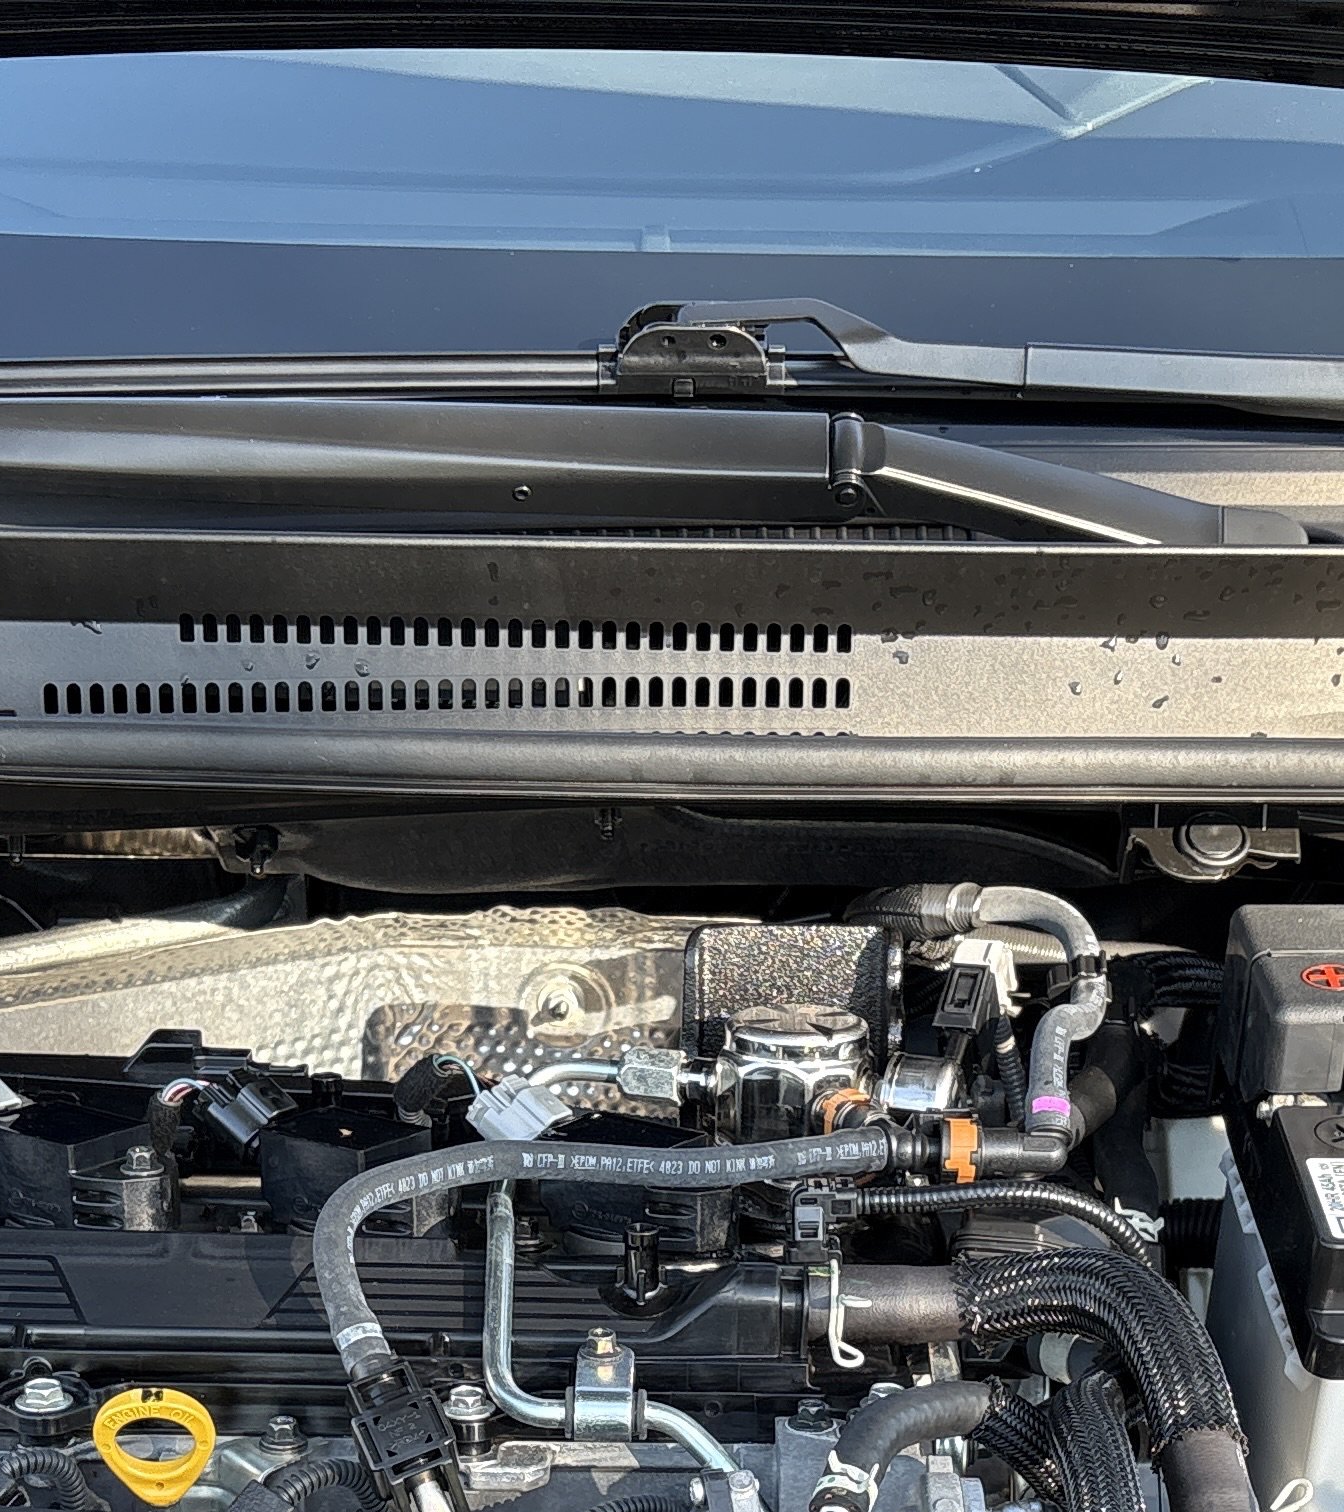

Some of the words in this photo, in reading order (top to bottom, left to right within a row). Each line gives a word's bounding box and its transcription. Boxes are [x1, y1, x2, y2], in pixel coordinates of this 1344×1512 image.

[688, 1160, 701, 1175] DO
[705, 1159, 722, 1174] NOT
[103, 1405, 162, 1430] ENGINE
[170, 1409, 196, 1426] OIL
